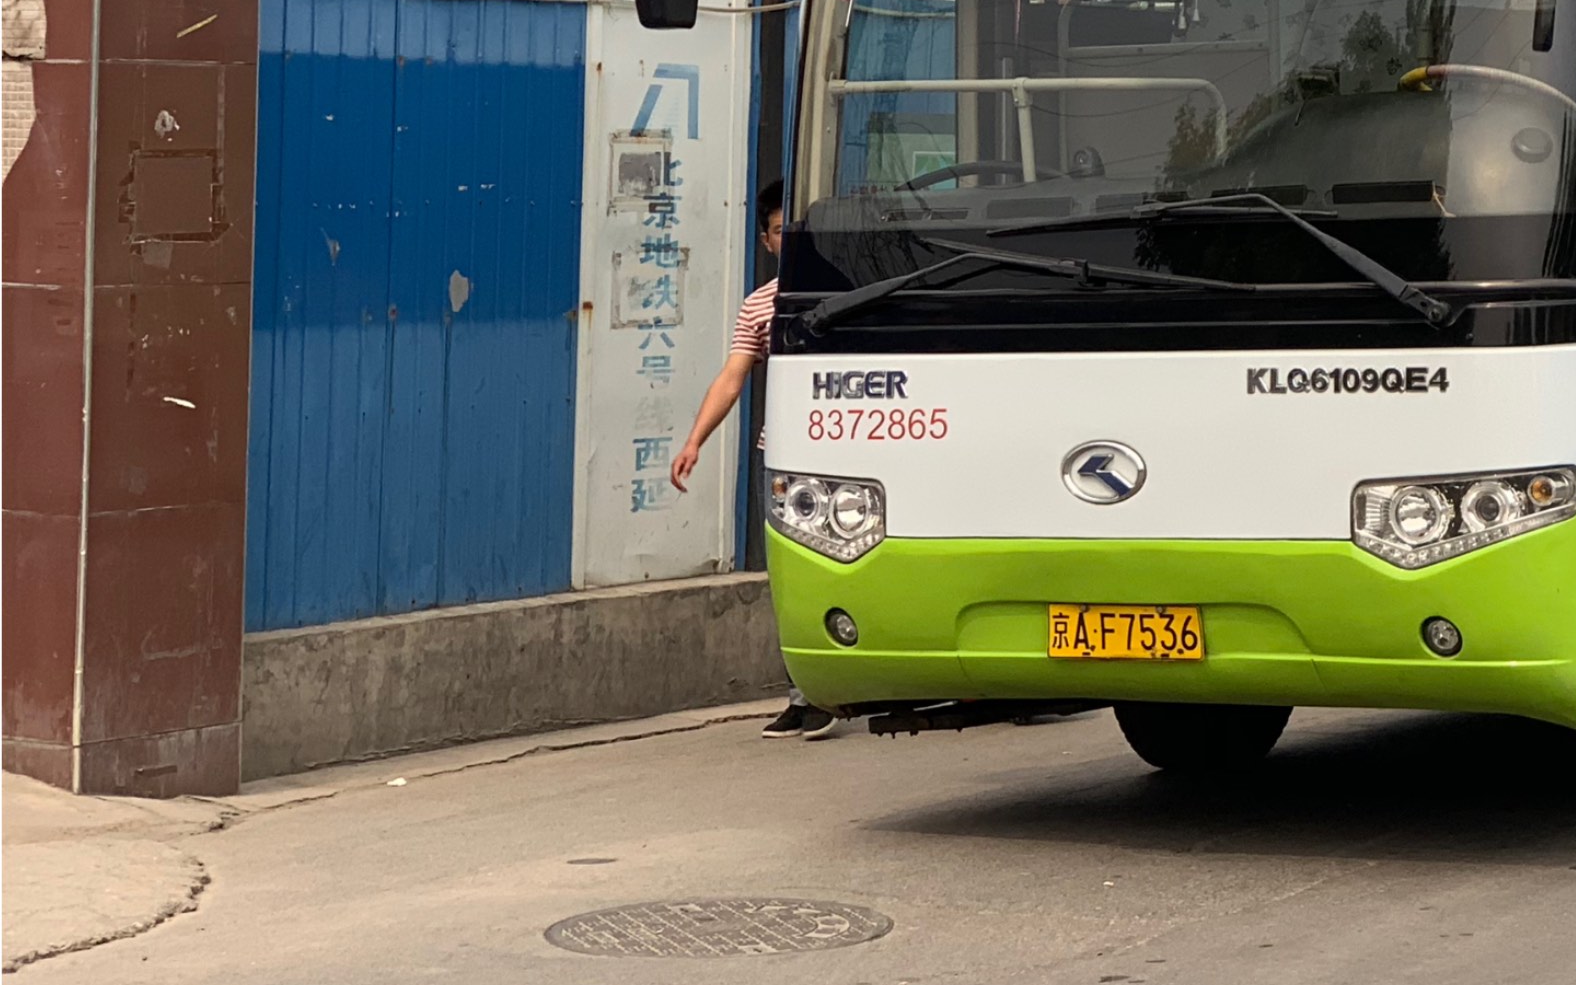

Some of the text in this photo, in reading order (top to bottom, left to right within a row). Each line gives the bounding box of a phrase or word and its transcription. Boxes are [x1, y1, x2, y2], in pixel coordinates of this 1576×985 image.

[812, 370, 908, 400] HIGER
[1247, 367, 1449, 394] KLQ6109QE4
[808, 409, 948, 440] 8372865
